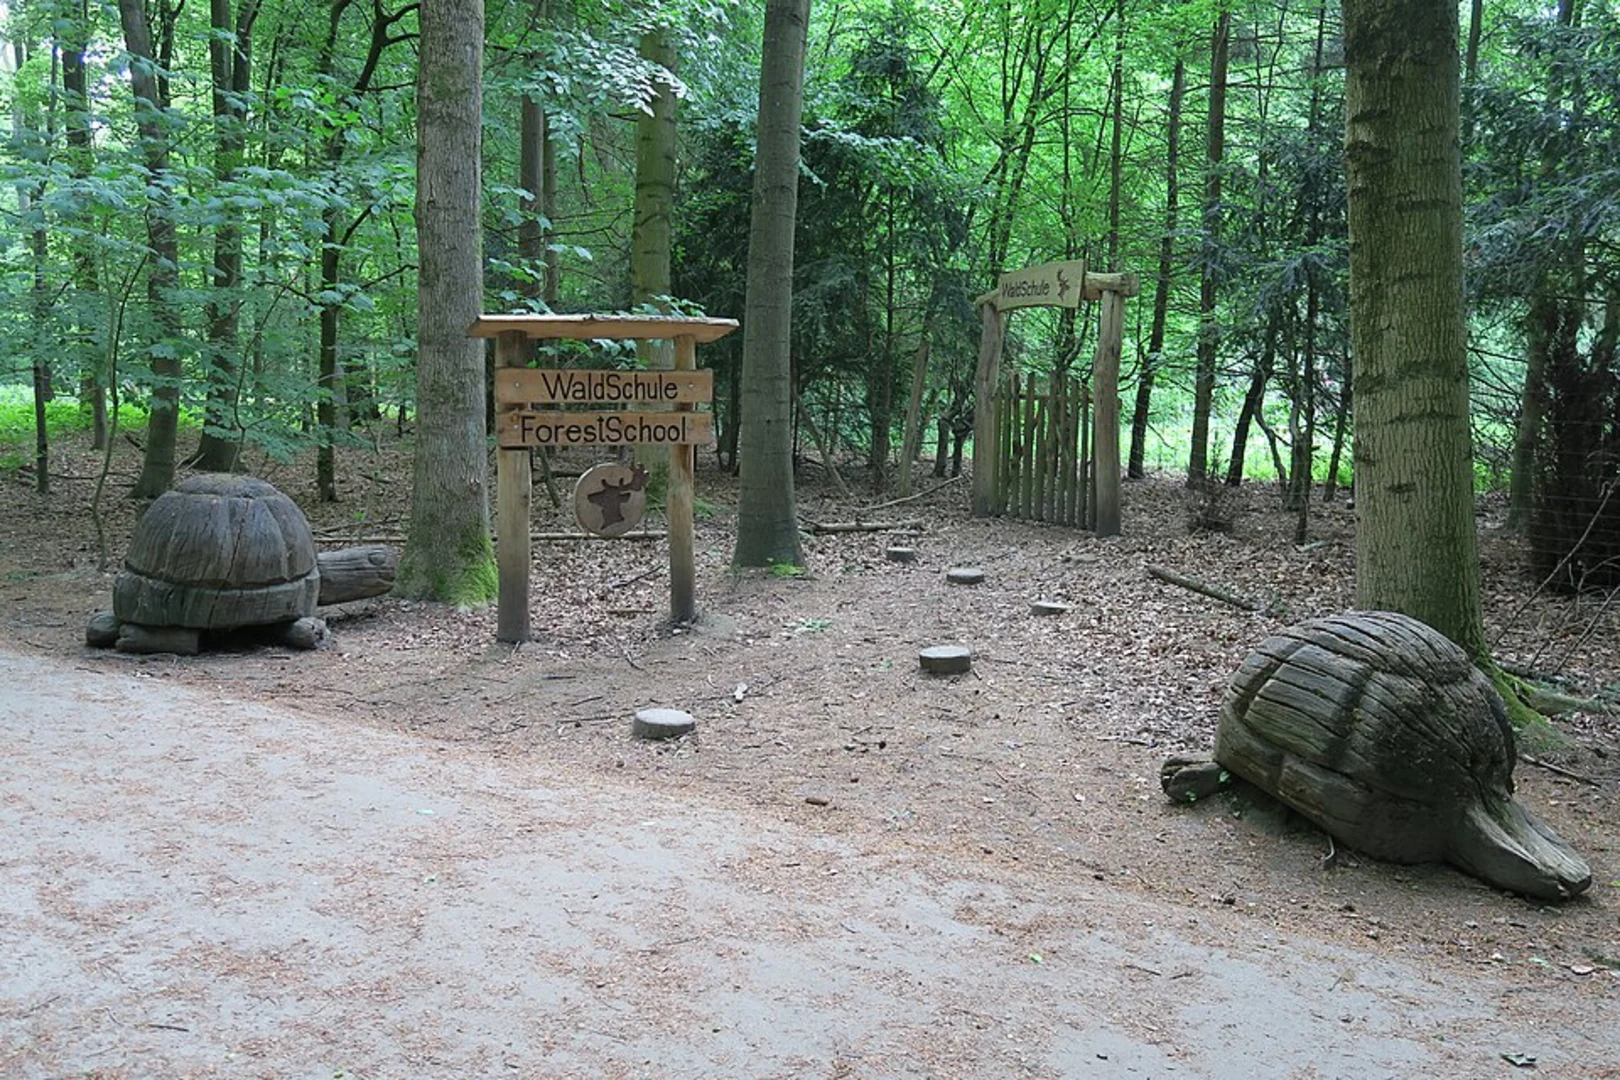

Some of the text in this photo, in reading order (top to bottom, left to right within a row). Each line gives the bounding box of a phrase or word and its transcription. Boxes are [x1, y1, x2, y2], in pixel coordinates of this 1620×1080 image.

[1002, 280, 1050, 298] WaldSchule
[541, 373, 679, 400] WaldSchule
[520, 416, 687, 443] ForestSchool
